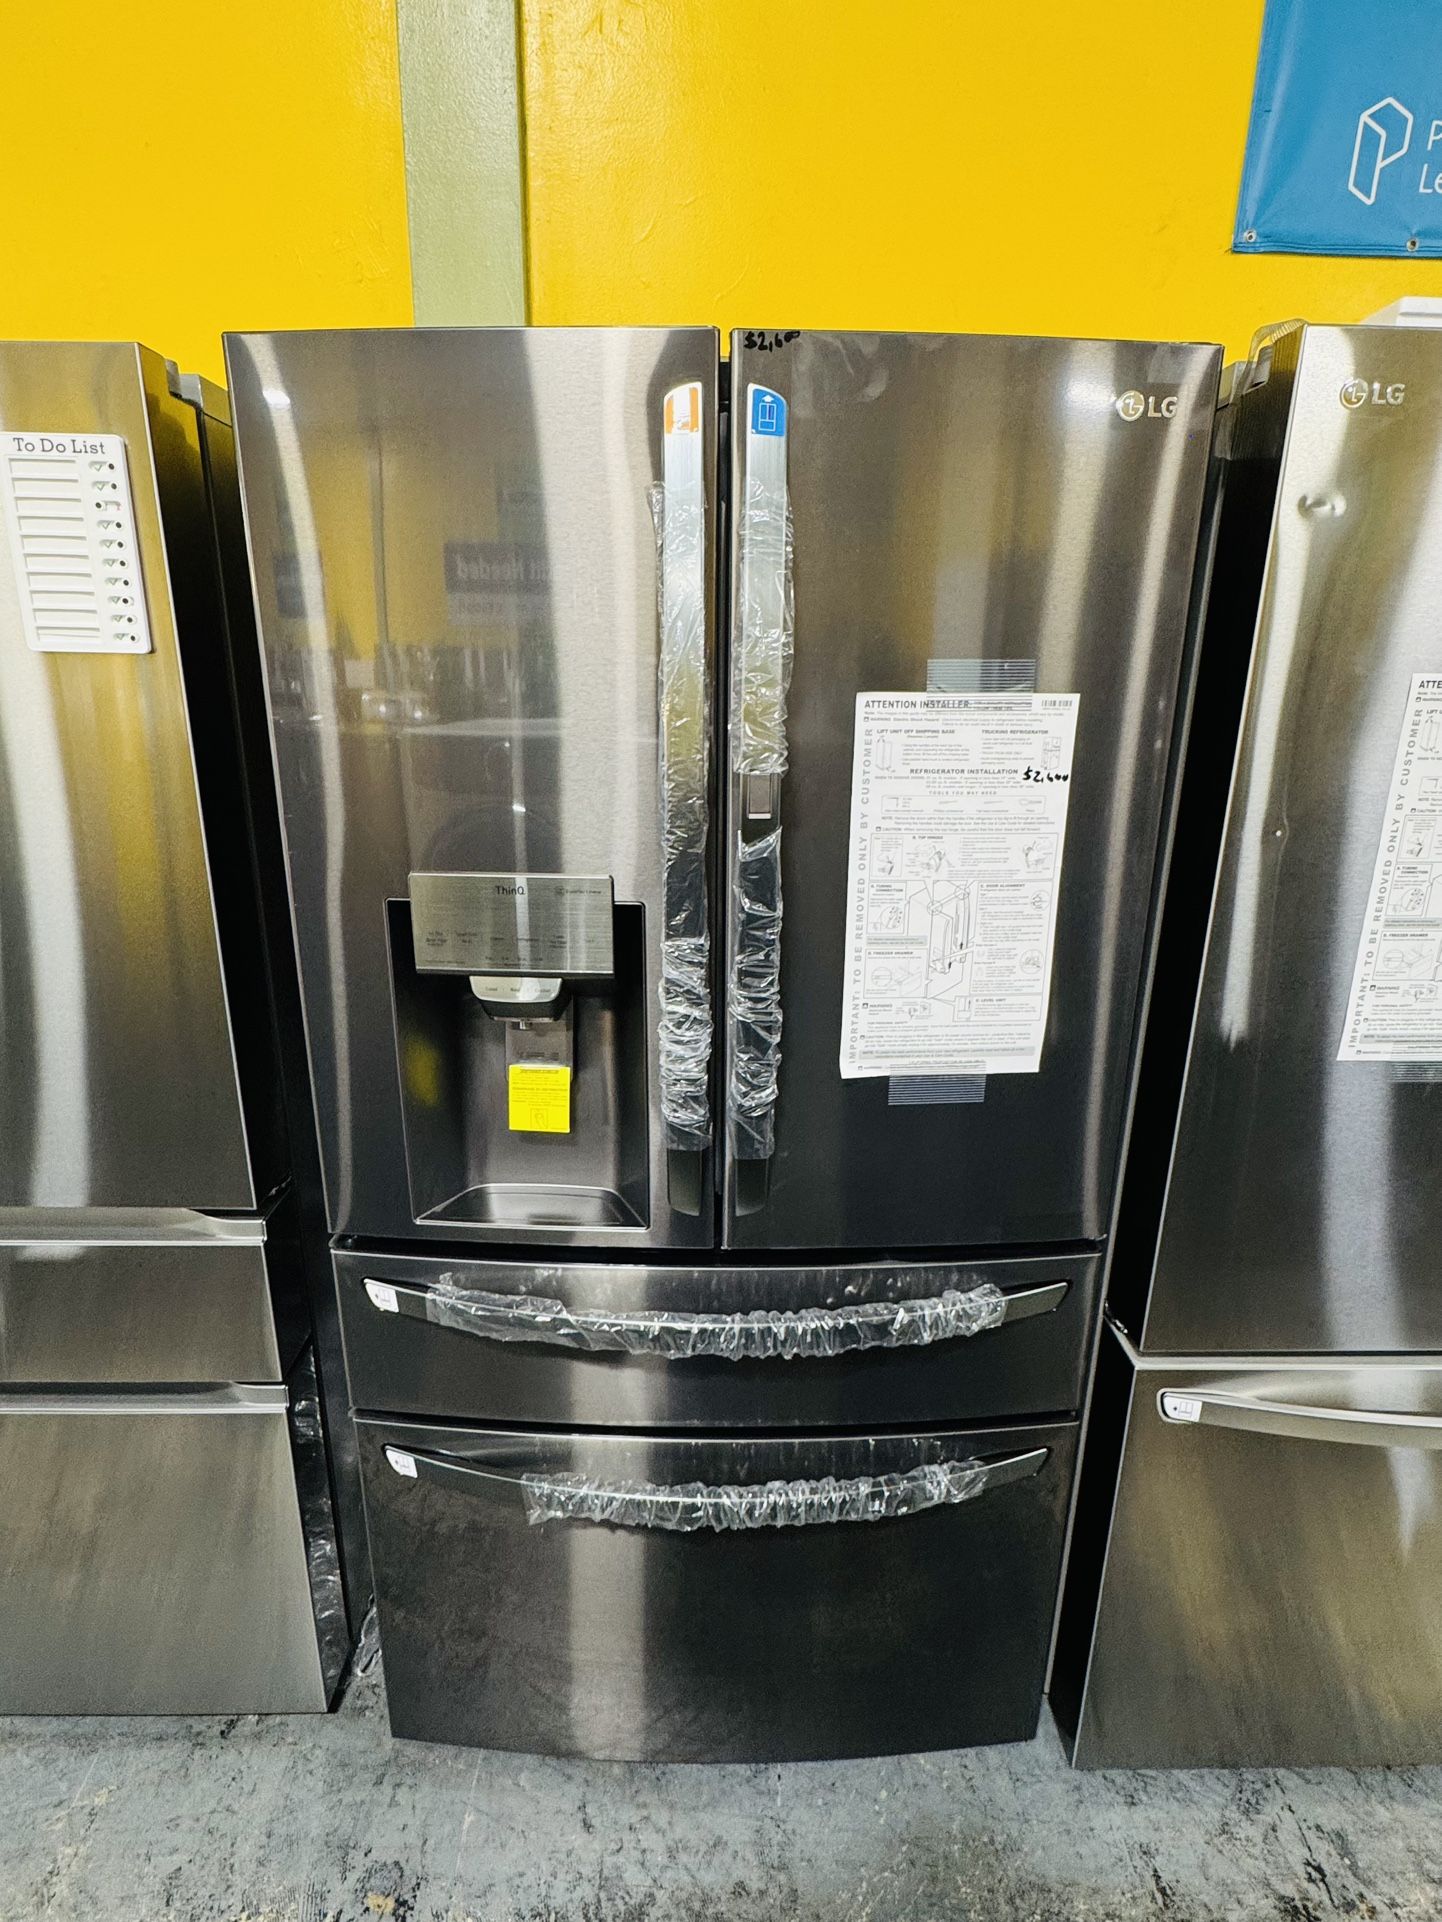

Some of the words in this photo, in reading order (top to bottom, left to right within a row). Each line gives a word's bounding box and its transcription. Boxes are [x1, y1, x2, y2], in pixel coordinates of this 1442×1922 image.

[1371, 382, 1405, 406] LG
[1147, 395, 1178, 419] LG
[13, 437, 36, 453] To
[41, 438, 66, 454] Do
[72, 439, 106, 455] List
[864, 700, 917, 709] ATTENTION
[1400, 708, 1423, 786] CUSTOMER
[861, 728, 873, 805] CUSTOMER
[1395, 794, 1405, 810] BY
[860, 812, 869, 829] BY
[1387, 818, 1400, 853] ONLY
[858, 836, 868, 871] ONLY
[495, 885, 526, 896] ThinQ
[1370, 859, 1392, 922] REMOVED
[855, 878, 865, 940] REMOVED
[1368, 928, 1379, 944] BE
[854, 946, 863, 962] BE
[1363, 951, 1374, 967] TO
[853, 968, 862, 984] TO
